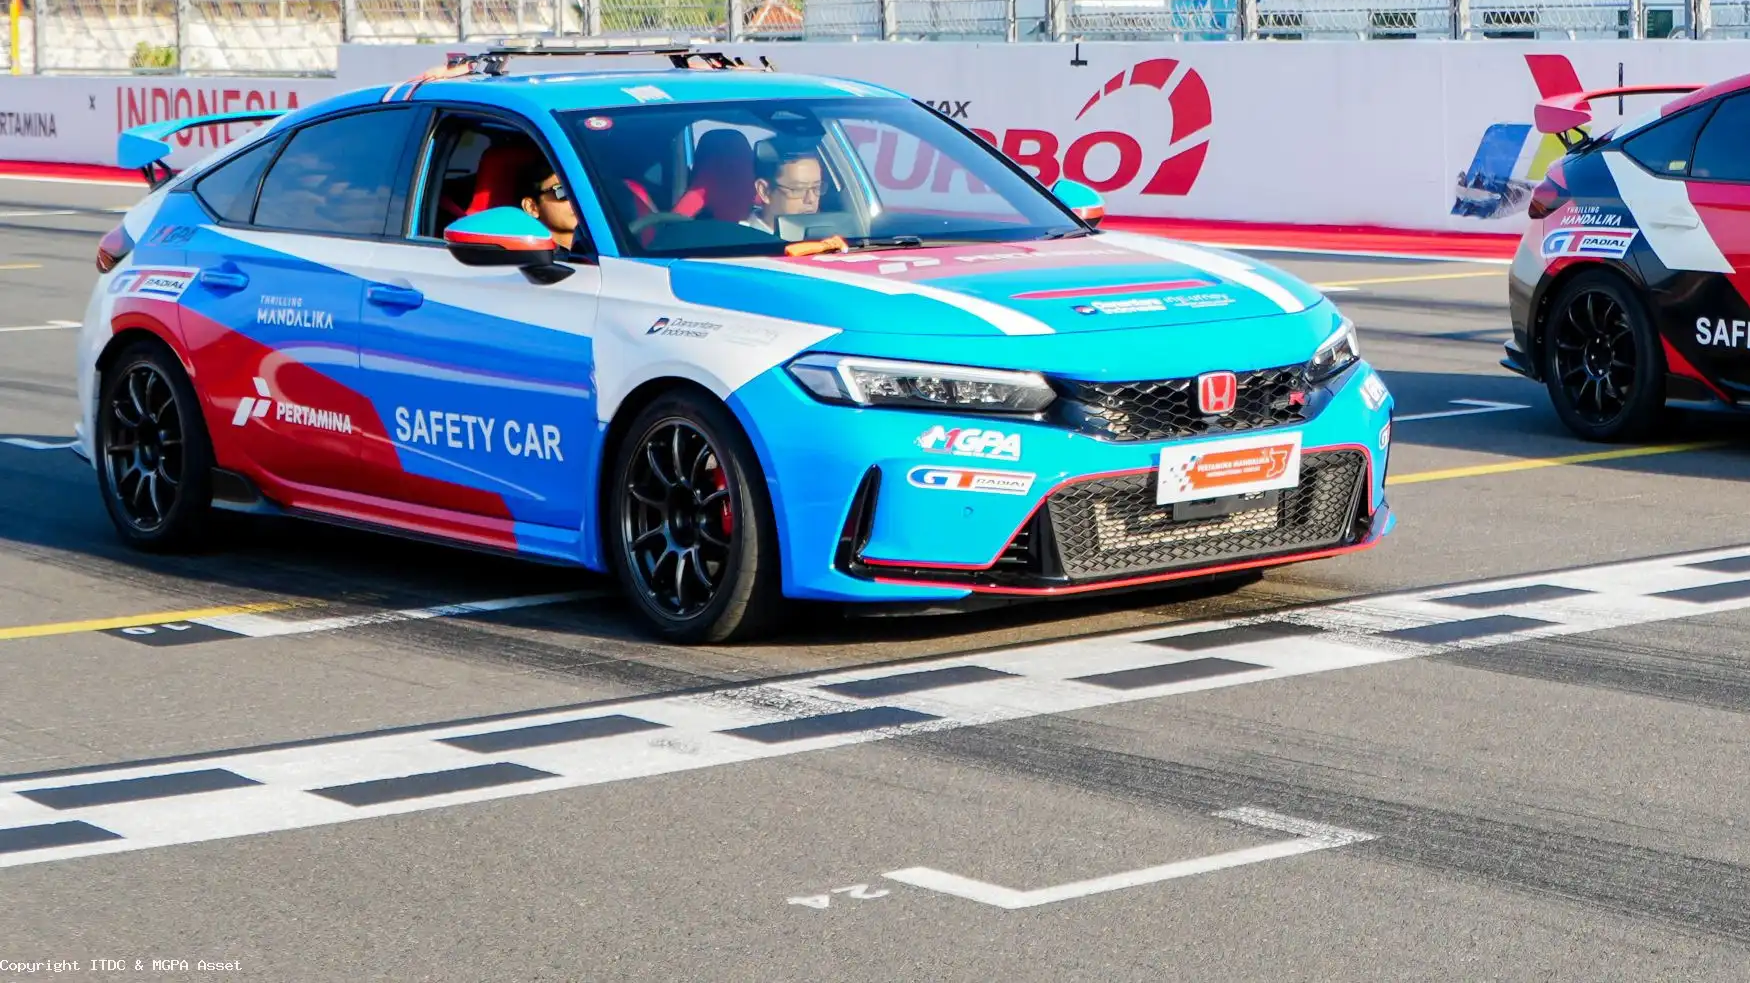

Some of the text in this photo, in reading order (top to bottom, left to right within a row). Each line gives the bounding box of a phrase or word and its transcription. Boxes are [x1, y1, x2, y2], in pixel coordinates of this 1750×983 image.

[1560, 213, 1622, 227] MANDALIKA
[1582, 238, 1627, 248] RADIAL
[144, 277, 185, 290] RADIAL
[260, 295, 303, 307] THRILLING
[256, 307, 334, 330] MANDALIKA
[276, 401, 353, 435] PERTAMINA
[395, 406, 564, 462] SAFETY CAR
